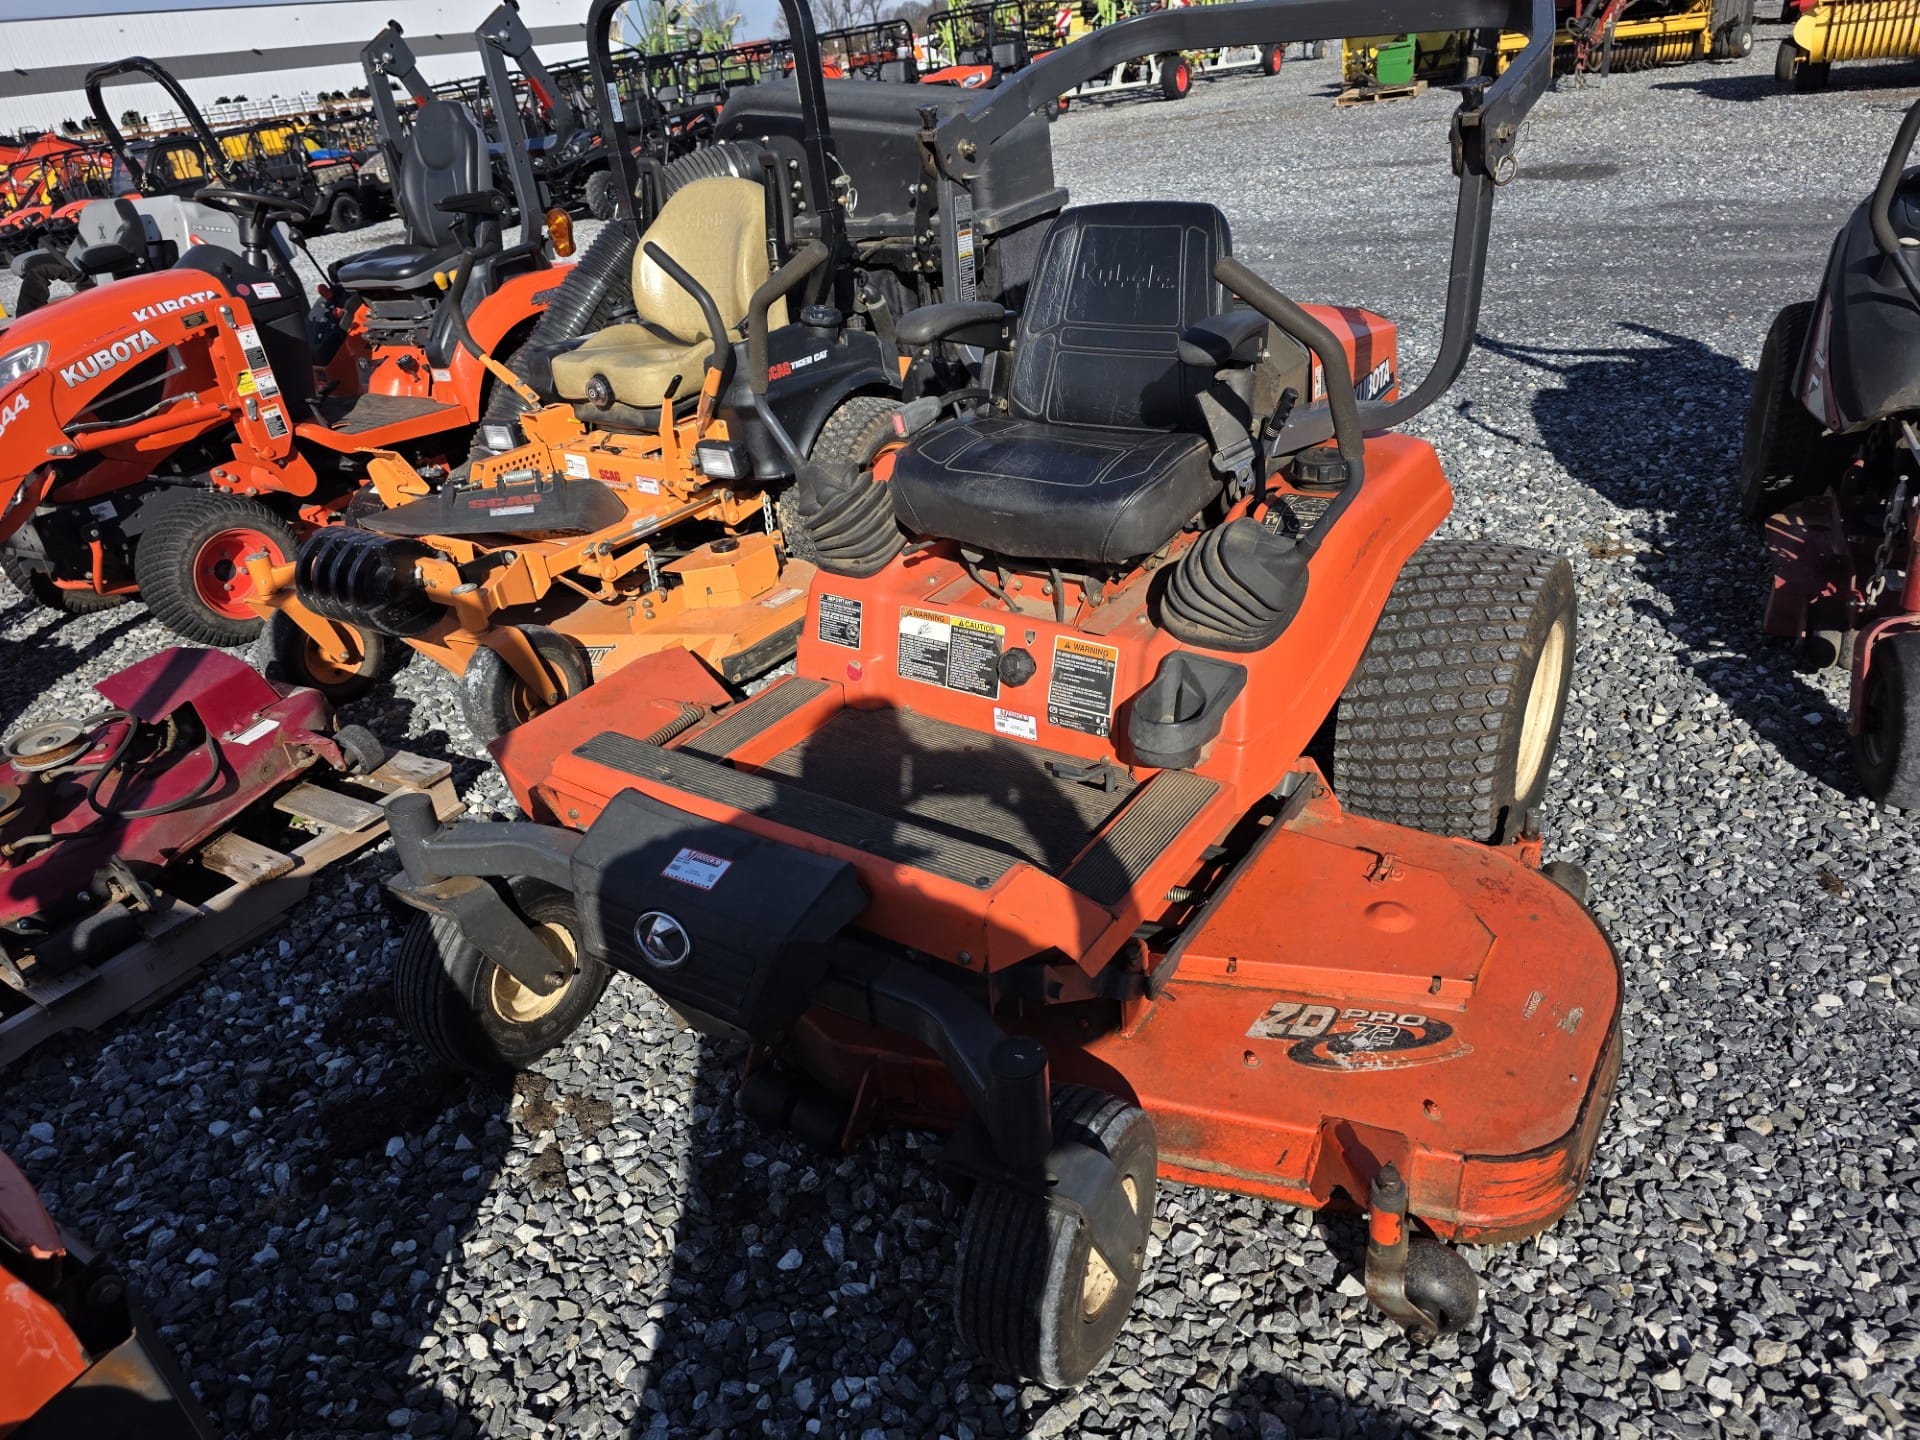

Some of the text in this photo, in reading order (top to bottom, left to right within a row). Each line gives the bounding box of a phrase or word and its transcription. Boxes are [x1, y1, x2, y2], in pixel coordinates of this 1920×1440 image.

[59, 329, 160, 389] KUBOTA
[790, 355, 813, 370] TIGER
[813, 349, 829, 362] CAT
[598, 469, 621, 481] SCAG
[468, 494, 542, 509] SCAG
[913, 609, 945, 623] WARNING
[964, 622, 995, 635] CAUTION
[1073, 642, 1109, 657] WARNING
[1245, 1001, 1428, 1038] ZD PRO
